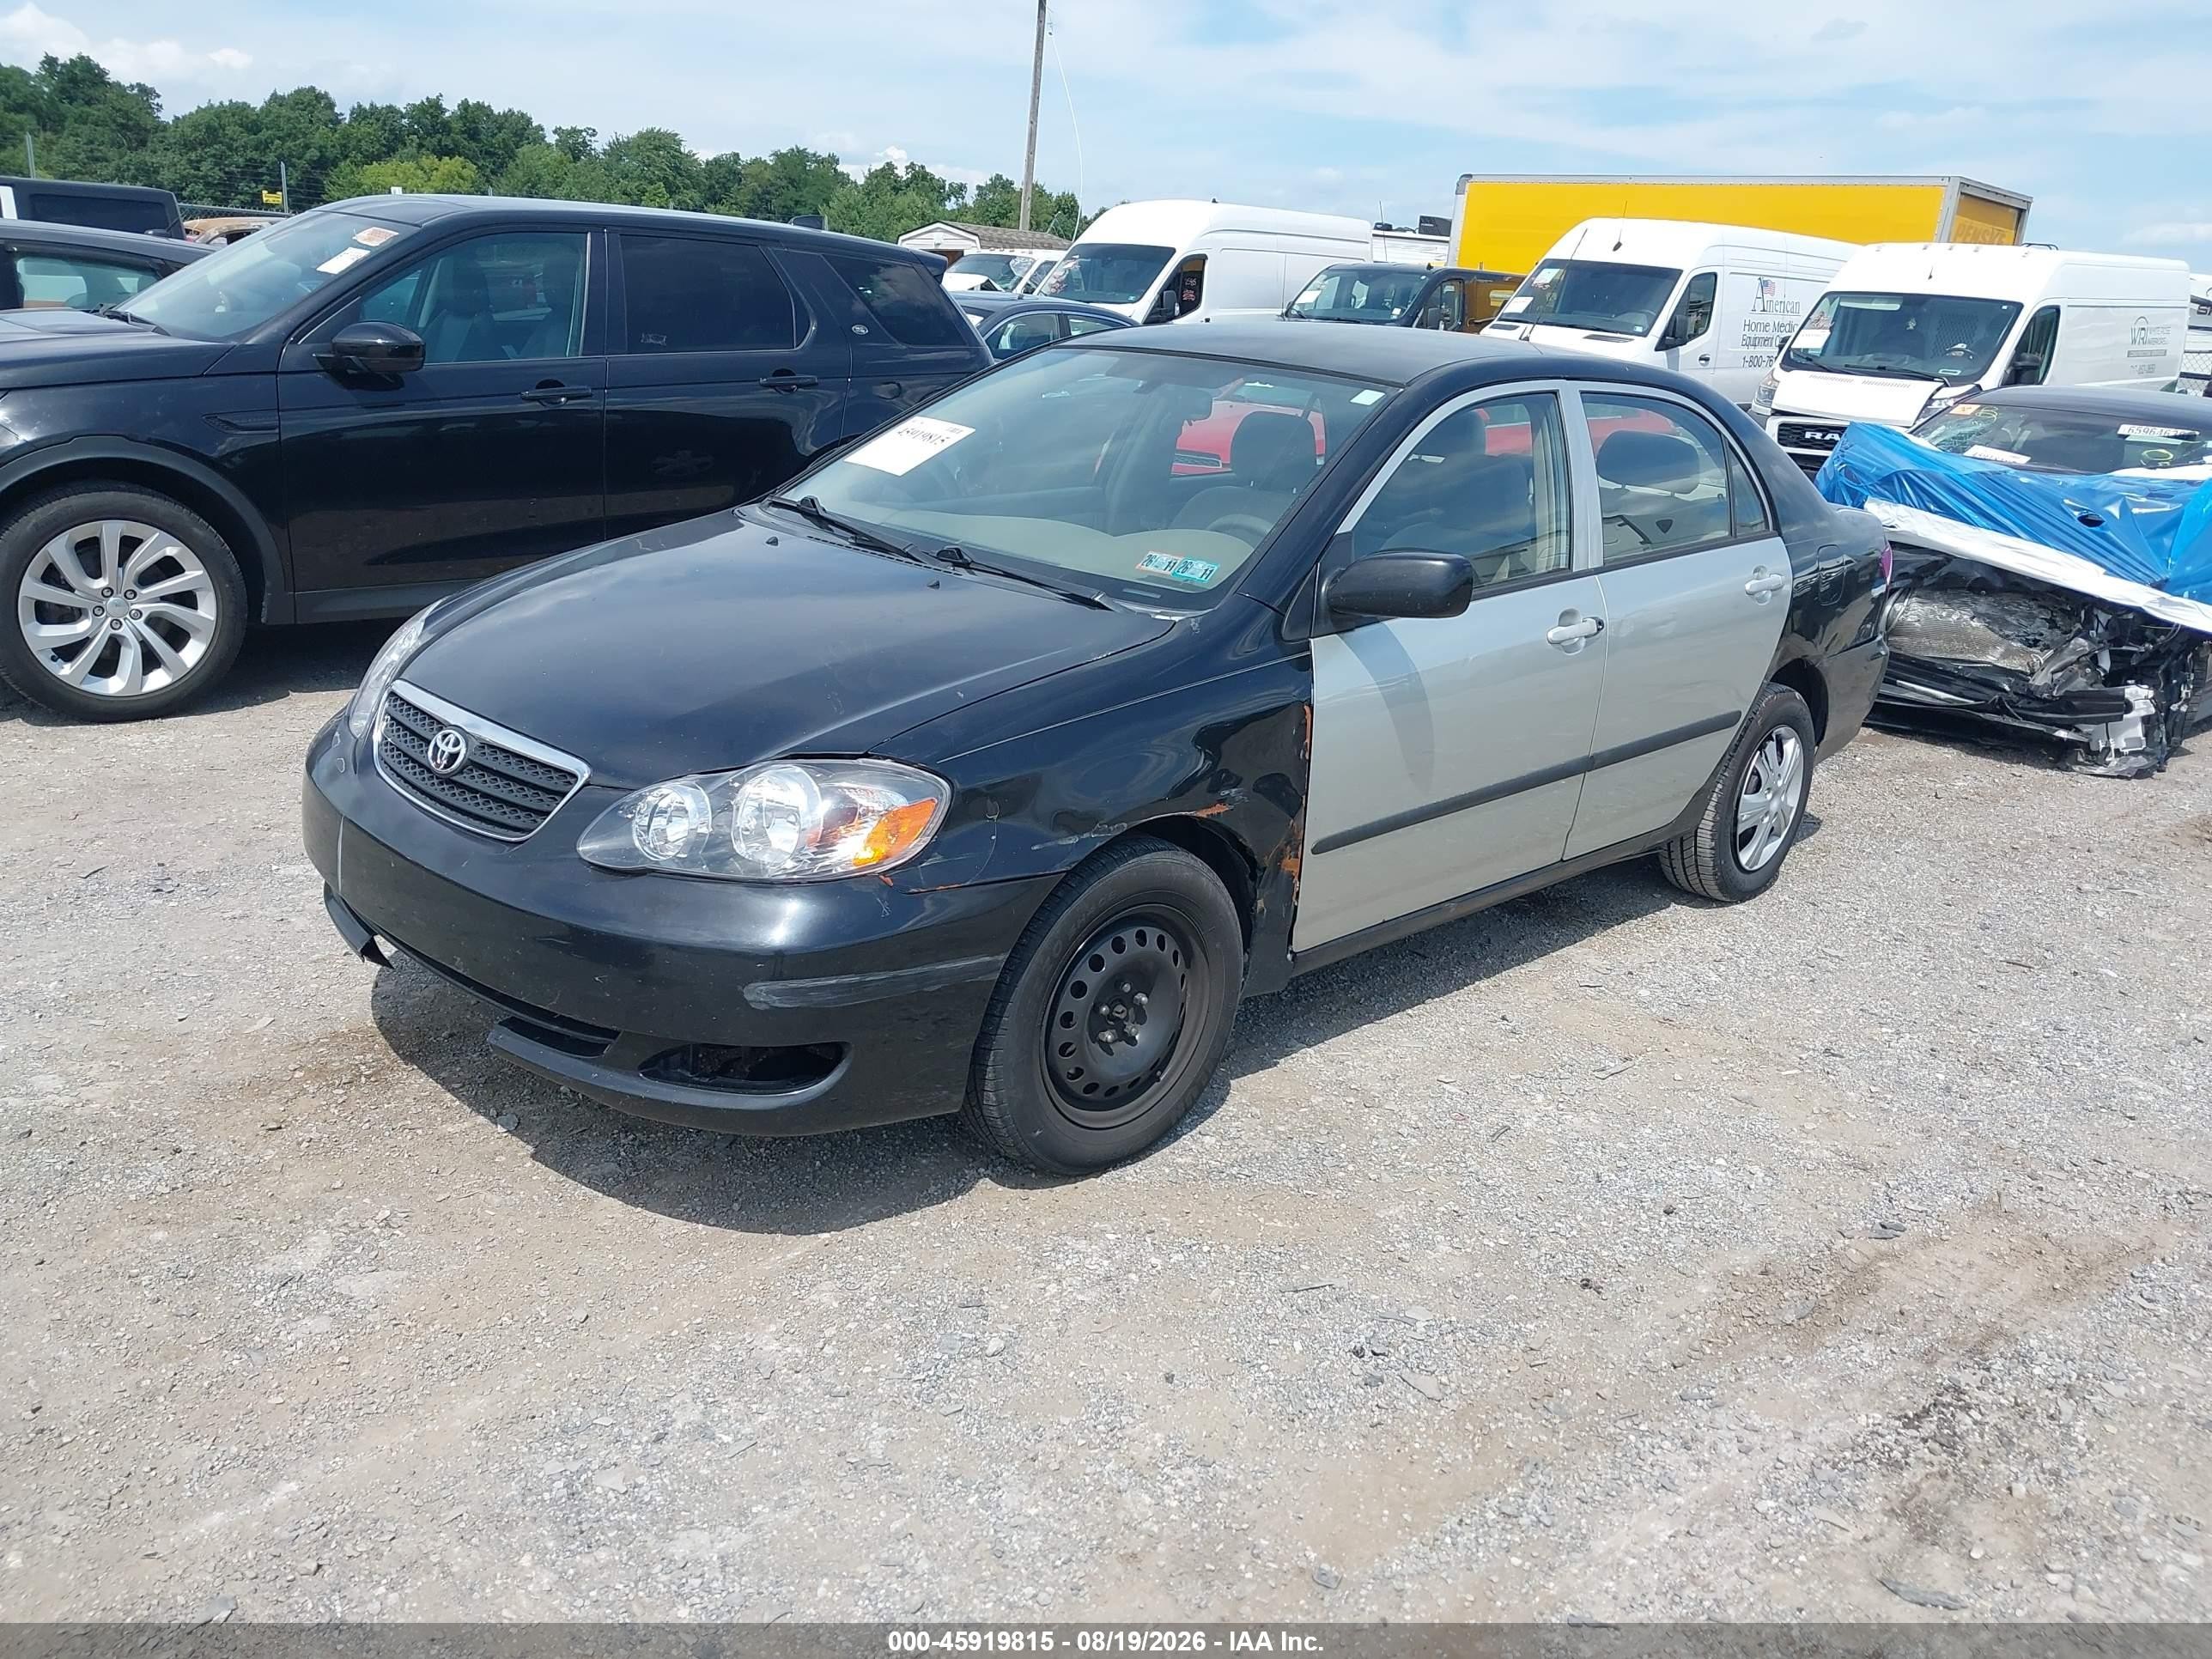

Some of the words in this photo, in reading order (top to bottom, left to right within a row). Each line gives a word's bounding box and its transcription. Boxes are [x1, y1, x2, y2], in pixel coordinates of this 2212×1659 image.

[1751, 276, 1801, 314] American
[1743, 319, 1771, 333] Home
[1741, 334, 1774, 349] Equipment
[1141, 554, 1157, 568] 26
[1176, 560, 1194, 574] 26
